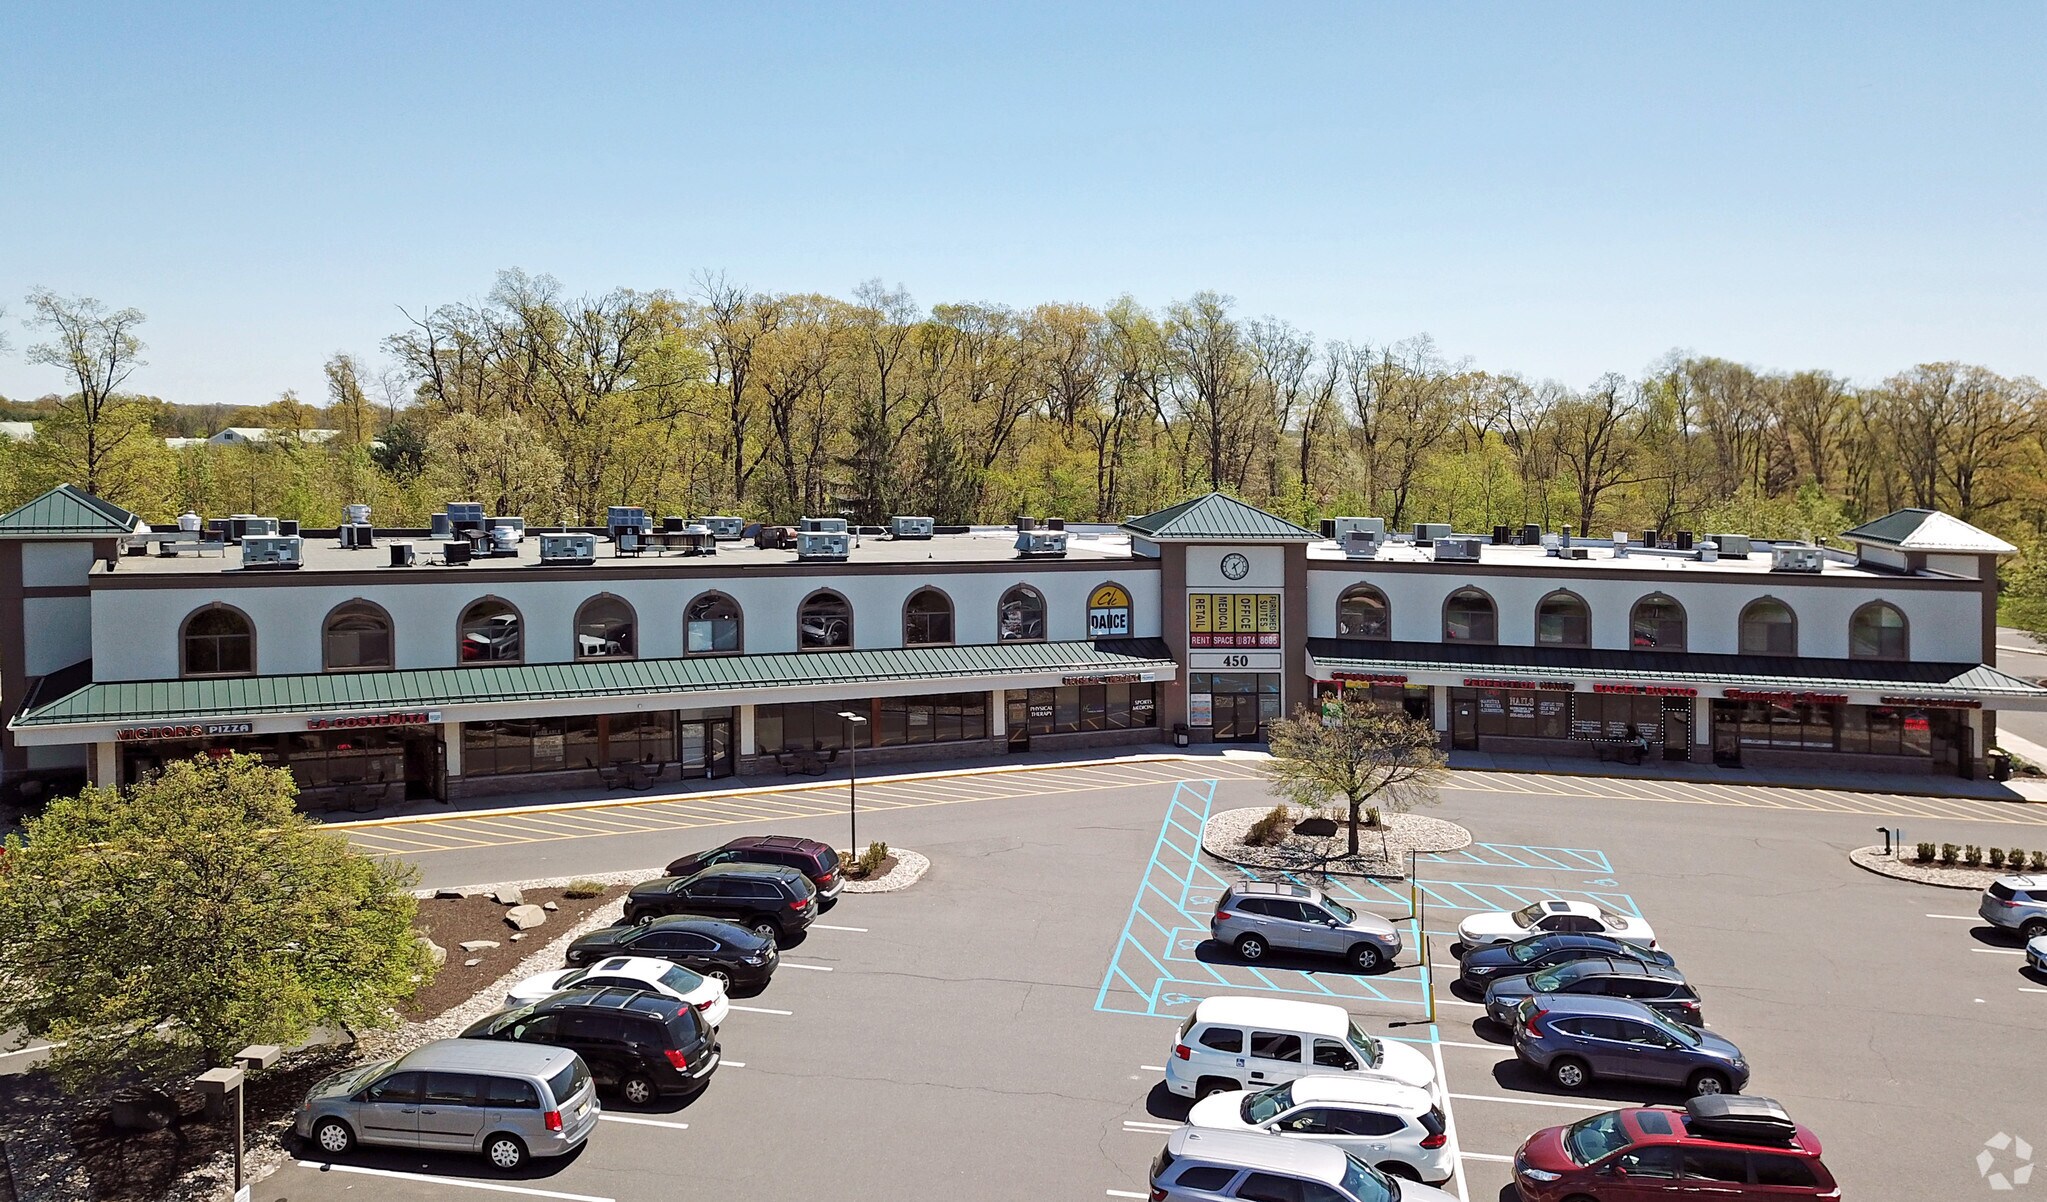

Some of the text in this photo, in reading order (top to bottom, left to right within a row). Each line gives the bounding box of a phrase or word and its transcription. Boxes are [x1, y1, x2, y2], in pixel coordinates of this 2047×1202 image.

[1091, 614, 1126, 629] DANCE
[1195, 598, 1206, 628] RETAIL
[1218, 596, 1228, 630] MEDICAL
[1240, 598, 1251, 629] OFFICE
[1260, 600, 1268, 627] SUITES
[1269, 596, 1277, 631] FURNISHED
[1191, 636, 1210, 645] RENT
[1213, 636, 1234, 645] SPACE
[1242, 636, 1256, 645] 874
[1223, 655, 1249, 667] 450
[1593, 683, 1698, 697] BAGEL BISTRO
[116, 723, 250, 741] VICTOR'S PIZZA
[308, 718, 330, 730] LA
